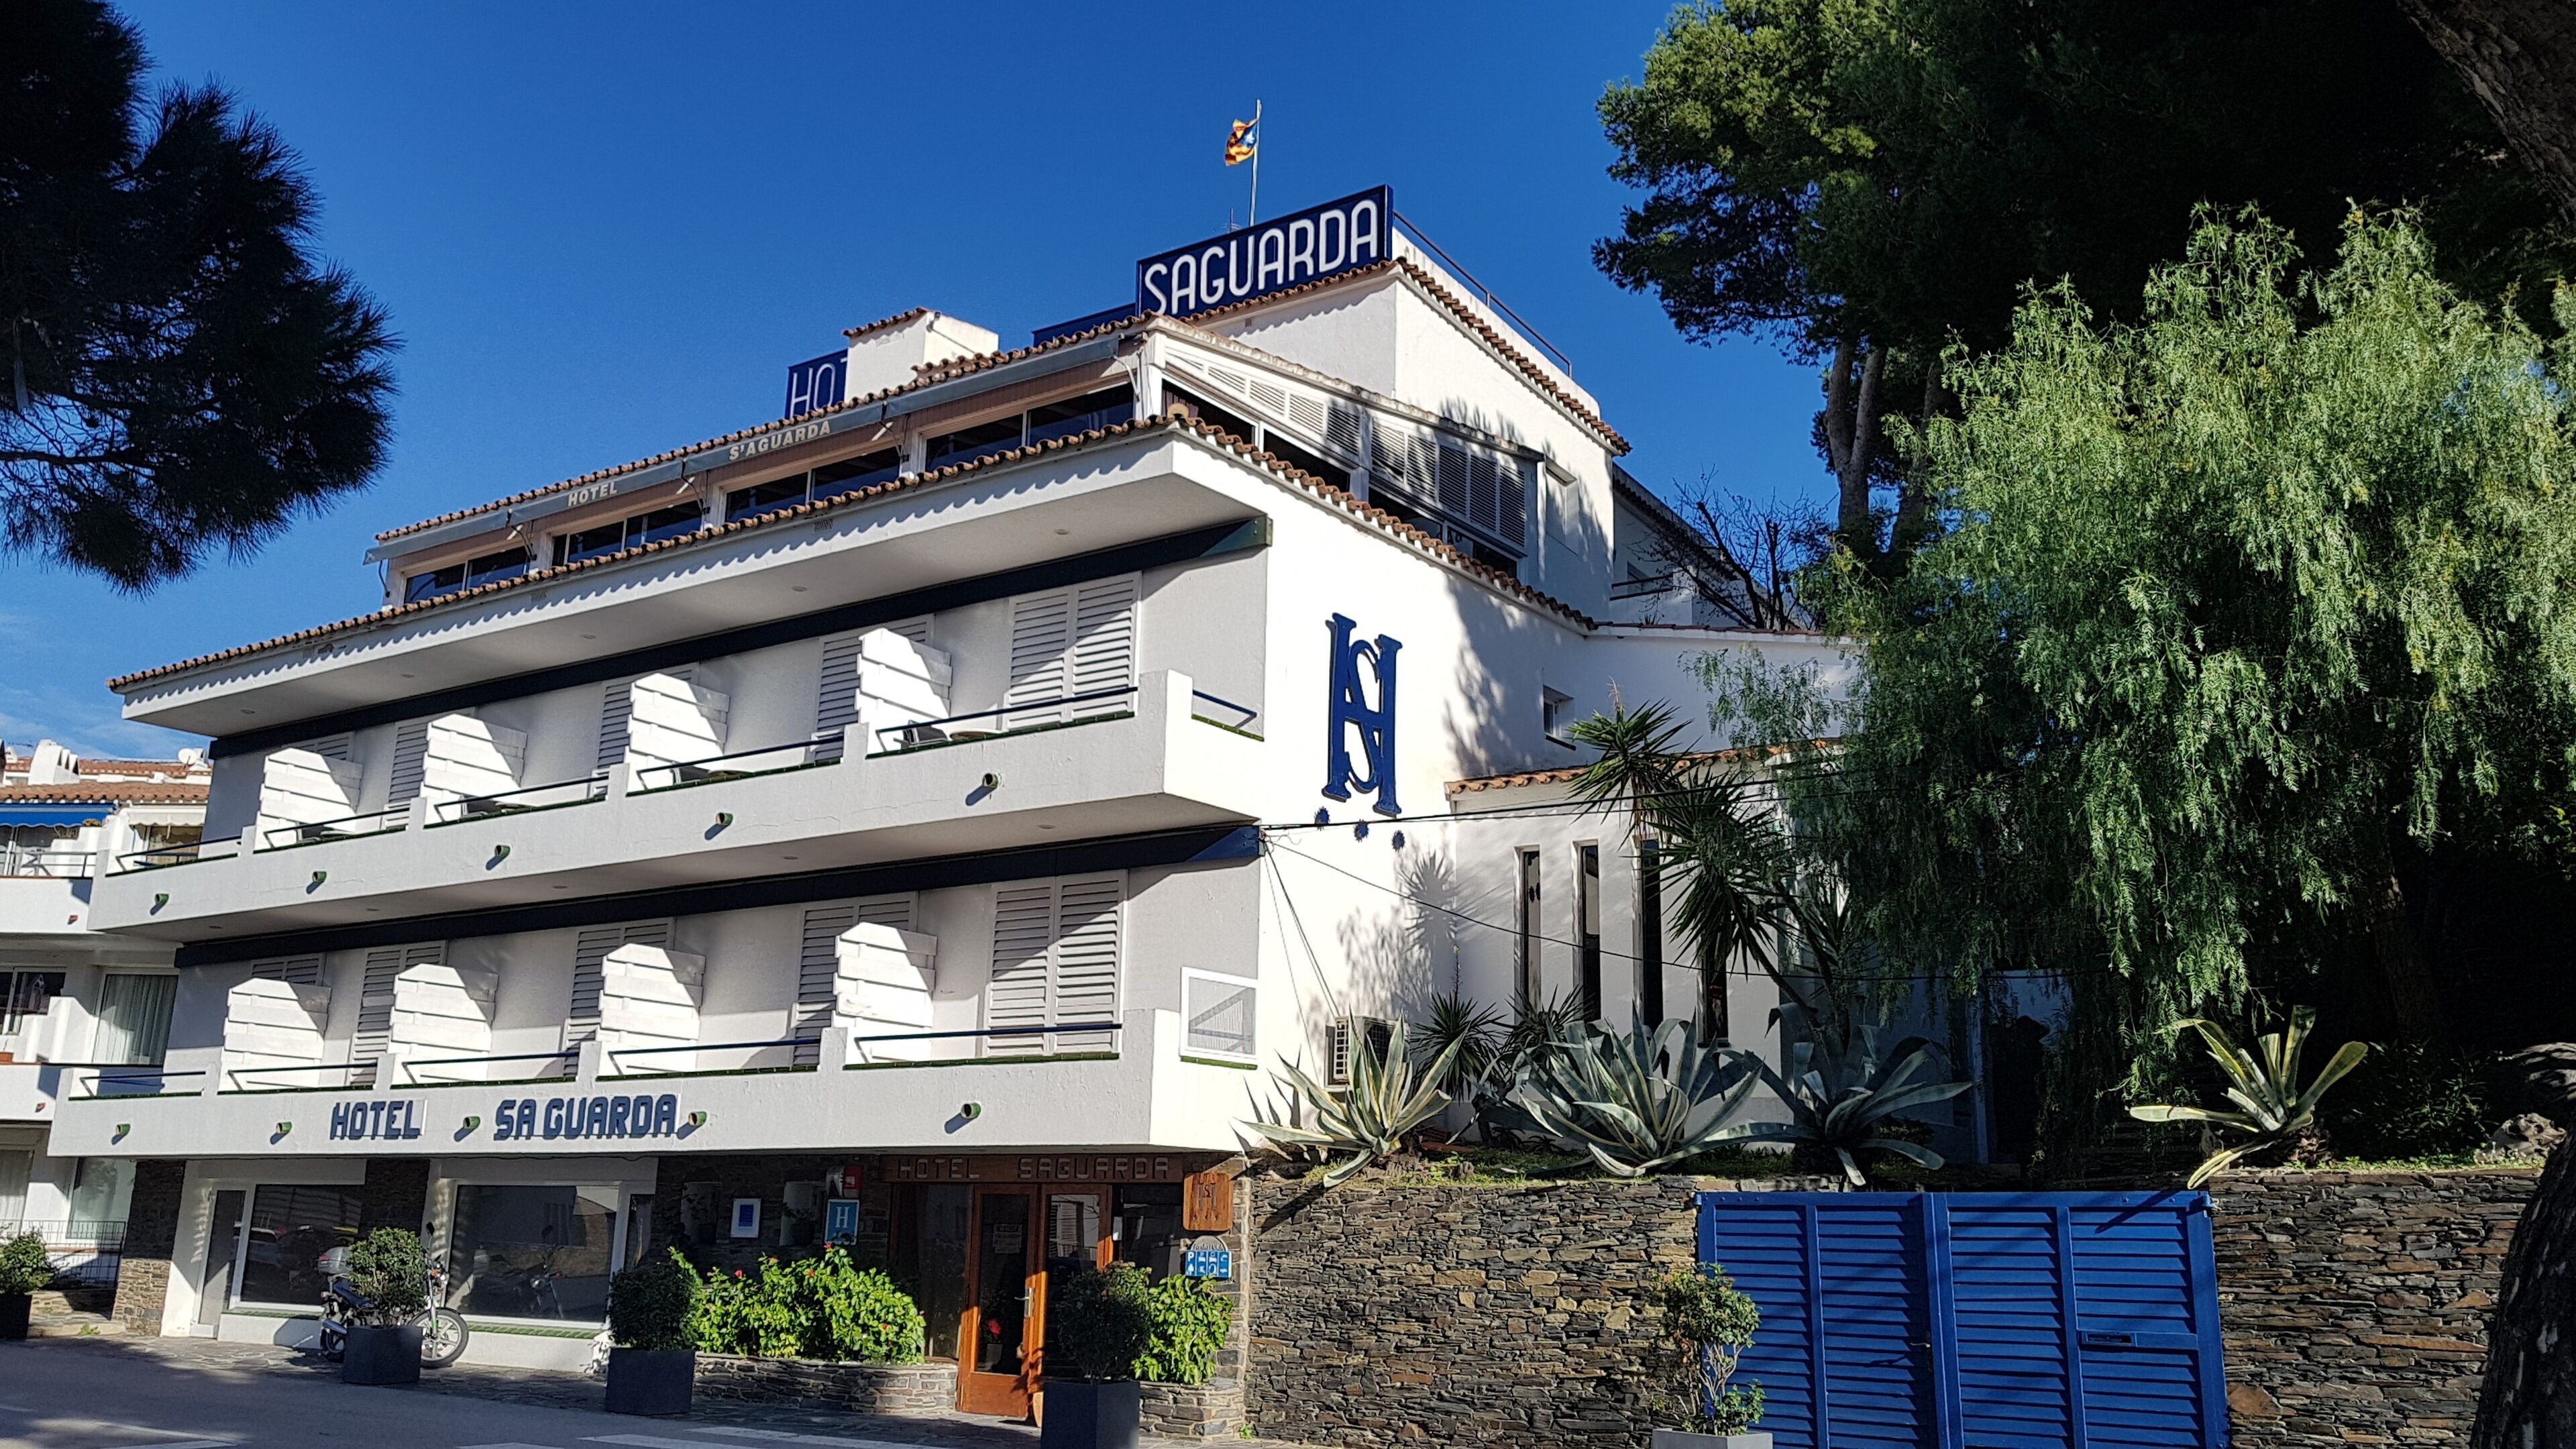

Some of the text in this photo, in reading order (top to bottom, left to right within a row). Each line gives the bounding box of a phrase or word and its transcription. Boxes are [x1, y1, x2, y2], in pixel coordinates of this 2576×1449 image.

[1144, 199, 1378, 315] SAGUARDA
[790, 357, 847, 417] HO
[568, 421, 831, 507] HOTEL S'AGUARDA
[331, 1100, 421, 1140] HOTEL
[544, 1093, 679, 1140] GUARDA
[896, 1157, 1169, 1179] HOTEL SAGUARDA
[835, 1206, 850, 1228] H
